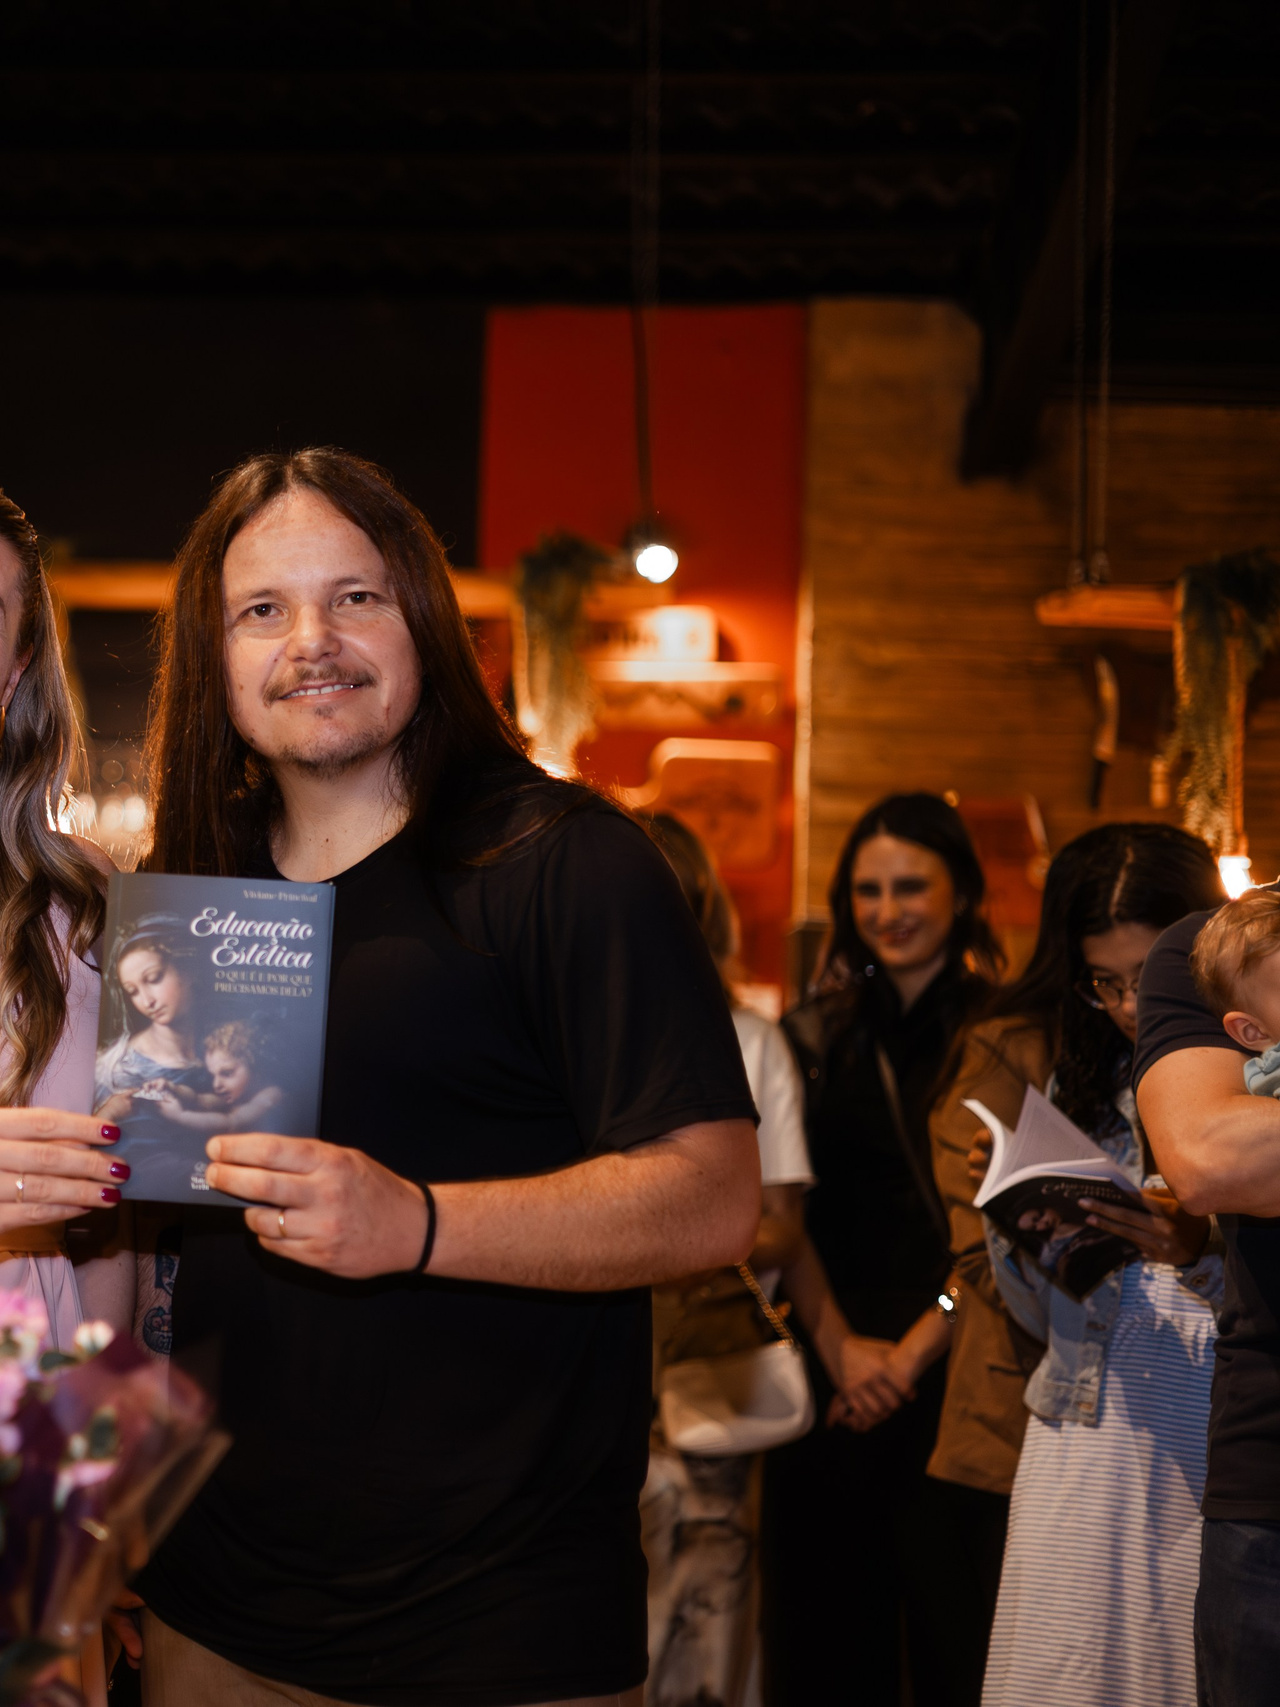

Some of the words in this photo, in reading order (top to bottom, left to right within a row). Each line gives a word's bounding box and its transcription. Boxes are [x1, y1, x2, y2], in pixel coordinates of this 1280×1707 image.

[190, 906, 315, 945] Educação
[211, 936, 314, 969] Estética
[214, 969, 226, 980] O
[226, 970, 248, 983] QUE
[289, 975, 313, 987] QUE
[214, 981, 279, 995] PRECISAMOS
